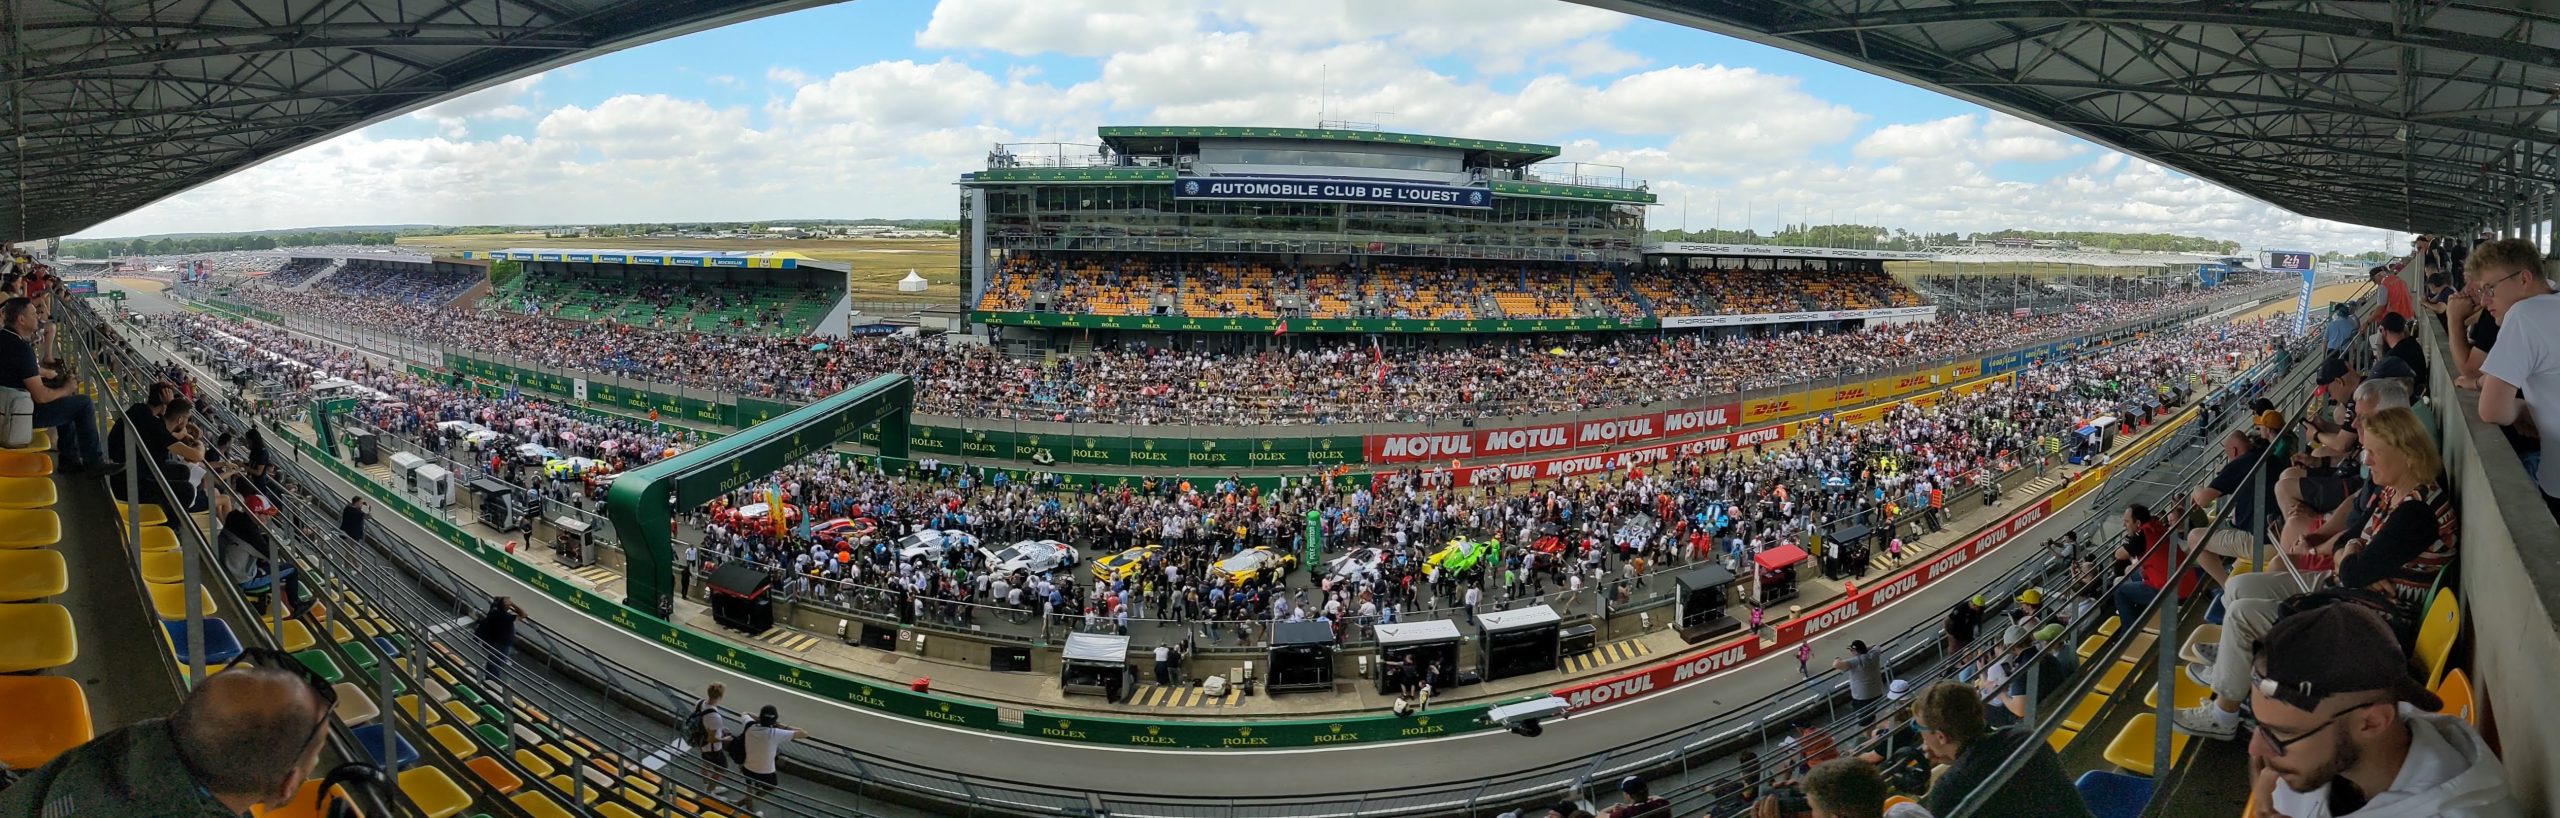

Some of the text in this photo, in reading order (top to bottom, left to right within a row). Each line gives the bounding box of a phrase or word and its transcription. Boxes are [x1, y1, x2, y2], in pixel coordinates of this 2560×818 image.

[1211, 183, 1460, 202] AUTOMOBILE CLUB DE L'OUEST
[1681, 244, 1729, 252] PORSCHE
[2295, 281, 2310, 334] MICHELIN
[1900, 376, 1926, 388] DHL
[598, 393, 616, 401] ROLEX
[1835, 388, 1865, 401] DHL
[1916, 397, 1931, 406] DHL
[876, 401, 893, 416] ROLEX
[1666, 408, 1727, 431] MOTUL
[1844, 413, 1863, 422] DHL
[835, 422, 855, 437] ROLEX
[1581, 418, 1652, 441] MOTUL
[1737, 427, 1779, 447] MOTUL
[911, 437, 943, 447] ROLEX
[1382, 434, 1472, 456] MOTUL
[1485, 427, 1567, 451] MOTUL
[784, 444, 809, 463] ROLEX
[963, 443, 996, 452] ROLEX
[1073, 449, 1109, 459] ROLEX
[1308, 450, 1344, 459] ROLEX
[1131, 452, 1167, 461] ROLEX
[1189, 453, 1226, 461] ROLEX
[1249, 452, 1286, 461] ROLEX
[1617, 447, 1668, 466] MOTUL
[1547, 455, 1604, 476] MOTUL
[720, 470, 751, 492] ROLEX
[2014, 507, 2042, 531] MOTUL
[451, 534, 465, 546] ROLEX
[1975, 528, 2008, 553] MOTUL
[497, 561, 514, 574] ROLEX
[1928, 551, 1967, 579] MOTUL
[531, 577, 550, 592] ROLEX
[1872, 573, 1918, 607] MOTUL
[569, 595, 590, 610] ROLEX
[612, 614, 637, 630] ROLEX
[1804, 601, 1860, 635] MOTUL
[661, 634, 688, 649] ROLEX
[716, 654, 747, 670] ROLEX
[1673, 645, 1747, 683] MOTUL
[779, 674, 812, 689] ROLEX
[1569, 675, 1654, 708] MOTUL
[849, 692, 885, 708] ROLEX
[925, 709, 965, 723] ROLEX
[1042, 727, 1086, 739] ROLEX
[1402, 724, 1444, 736] ROLEX
[1132, 735, 1176, 744] ROLEX
[1223, 736, 1268, 745] ROLEX
[1314, 733, 1358, 743] ROLEX
